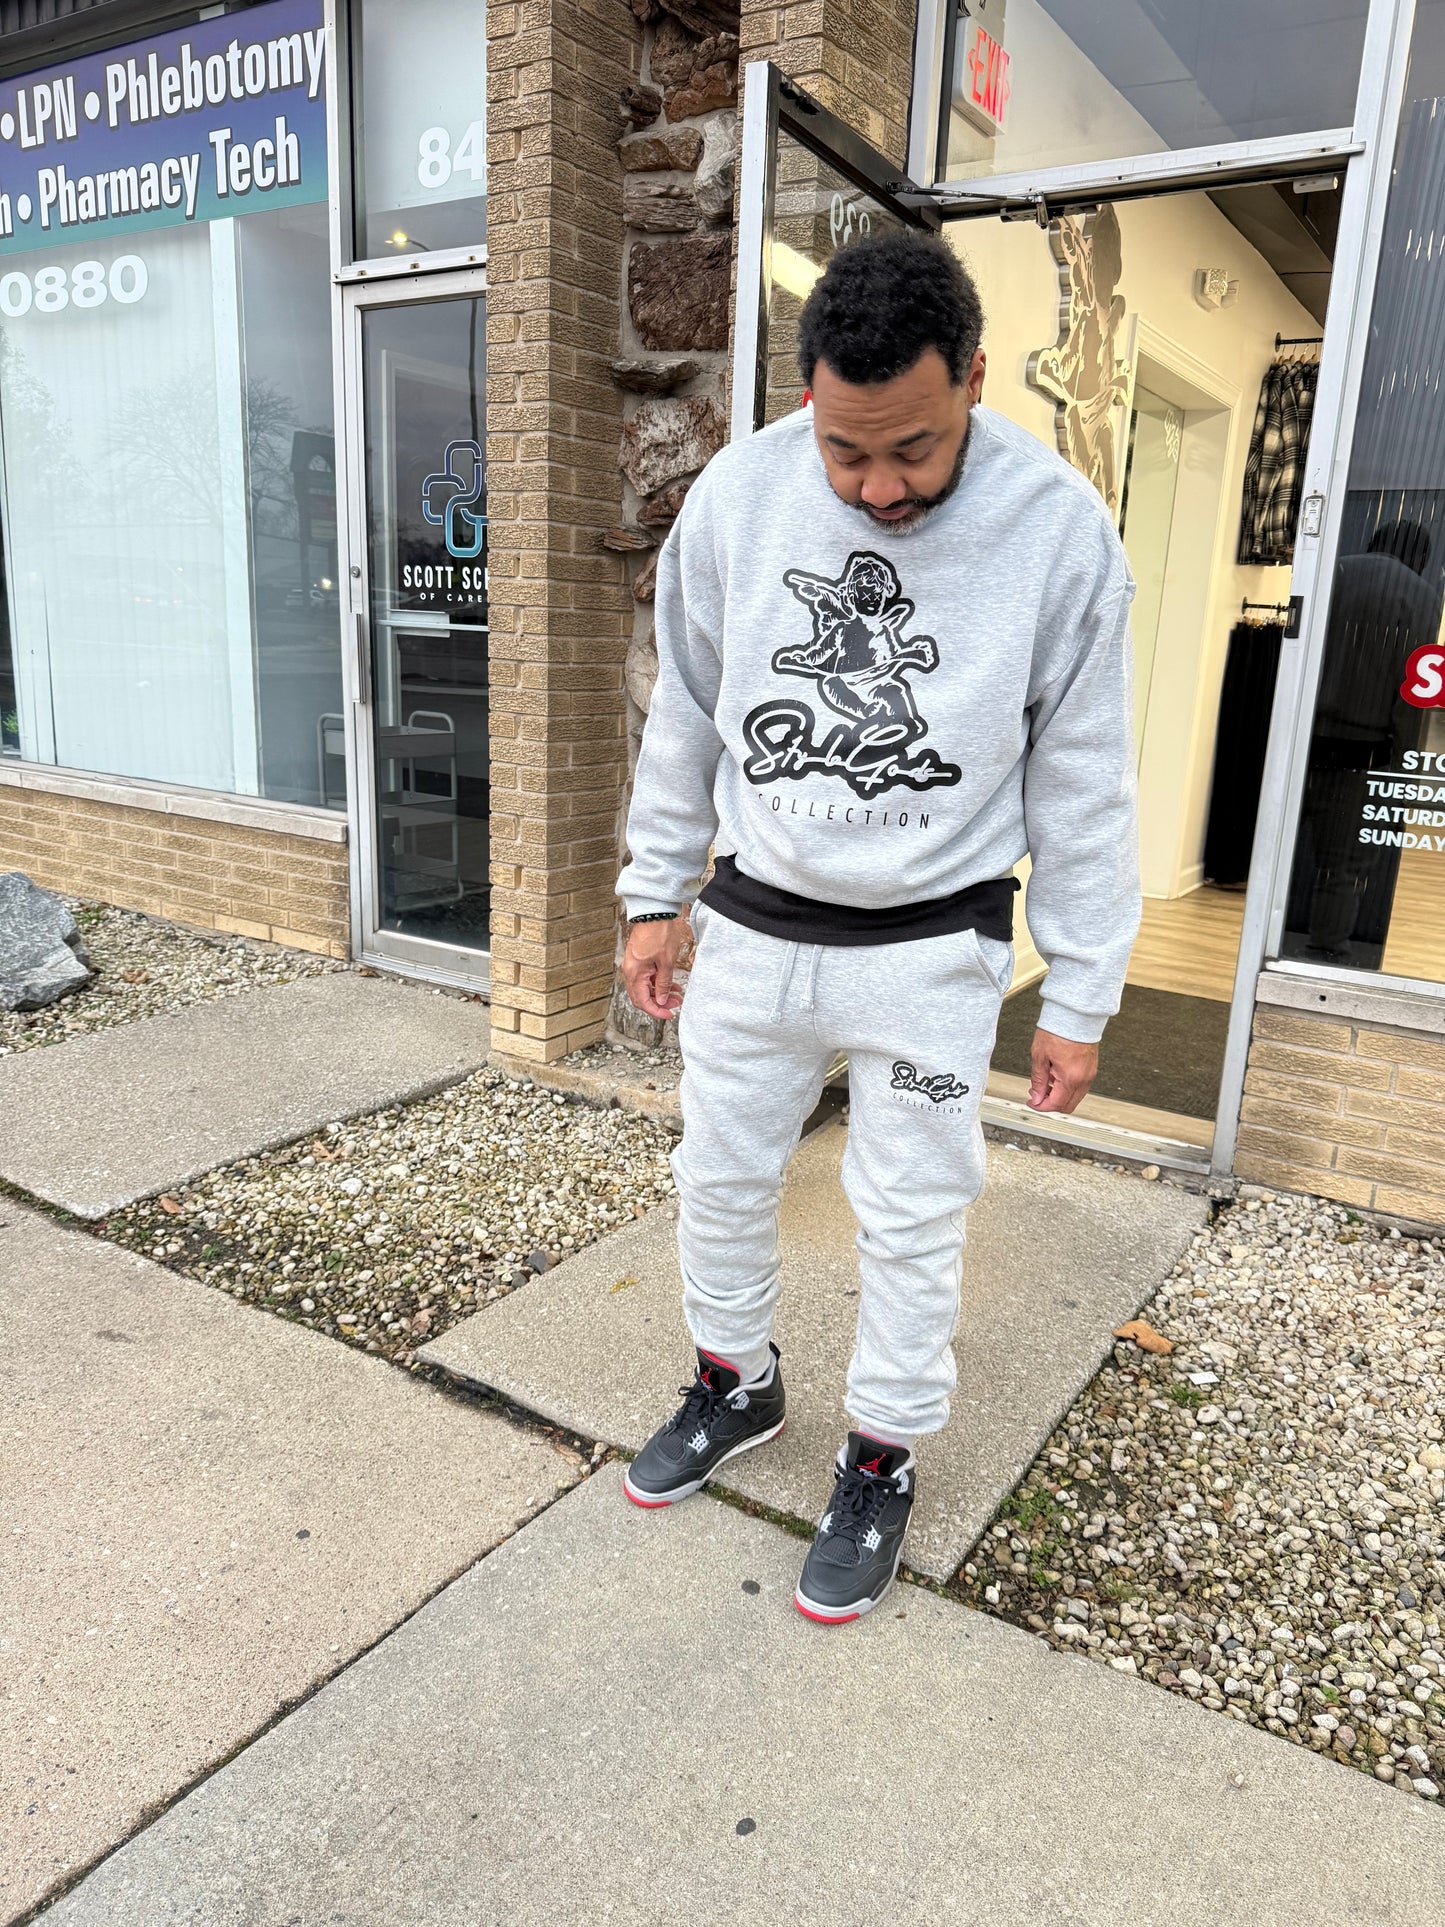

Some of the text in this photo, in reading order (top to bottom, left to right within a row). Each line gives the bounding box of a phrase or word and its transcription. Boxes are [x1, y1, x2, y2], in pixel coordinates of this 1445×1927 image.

[972, 26, 1010, 122] EXIT
[17, 27, 326, 148] LPN Phlebotomy
[38, 153, 200, 228] Pharmacy
[209, 116, 300, 194] Tech
[0, 254, 148, 317] 0880
[403, 565, 454, 588] SCOTT
[420, 592, 483, 603] OF CARE
[1366, 780, 1445, 803] TUESDA
[1362, 804, 1445, 827] SATURD
[1358, 828, 1445, 852] SUNDAY
[893, 1092, 962, 1113] COLLECTION
